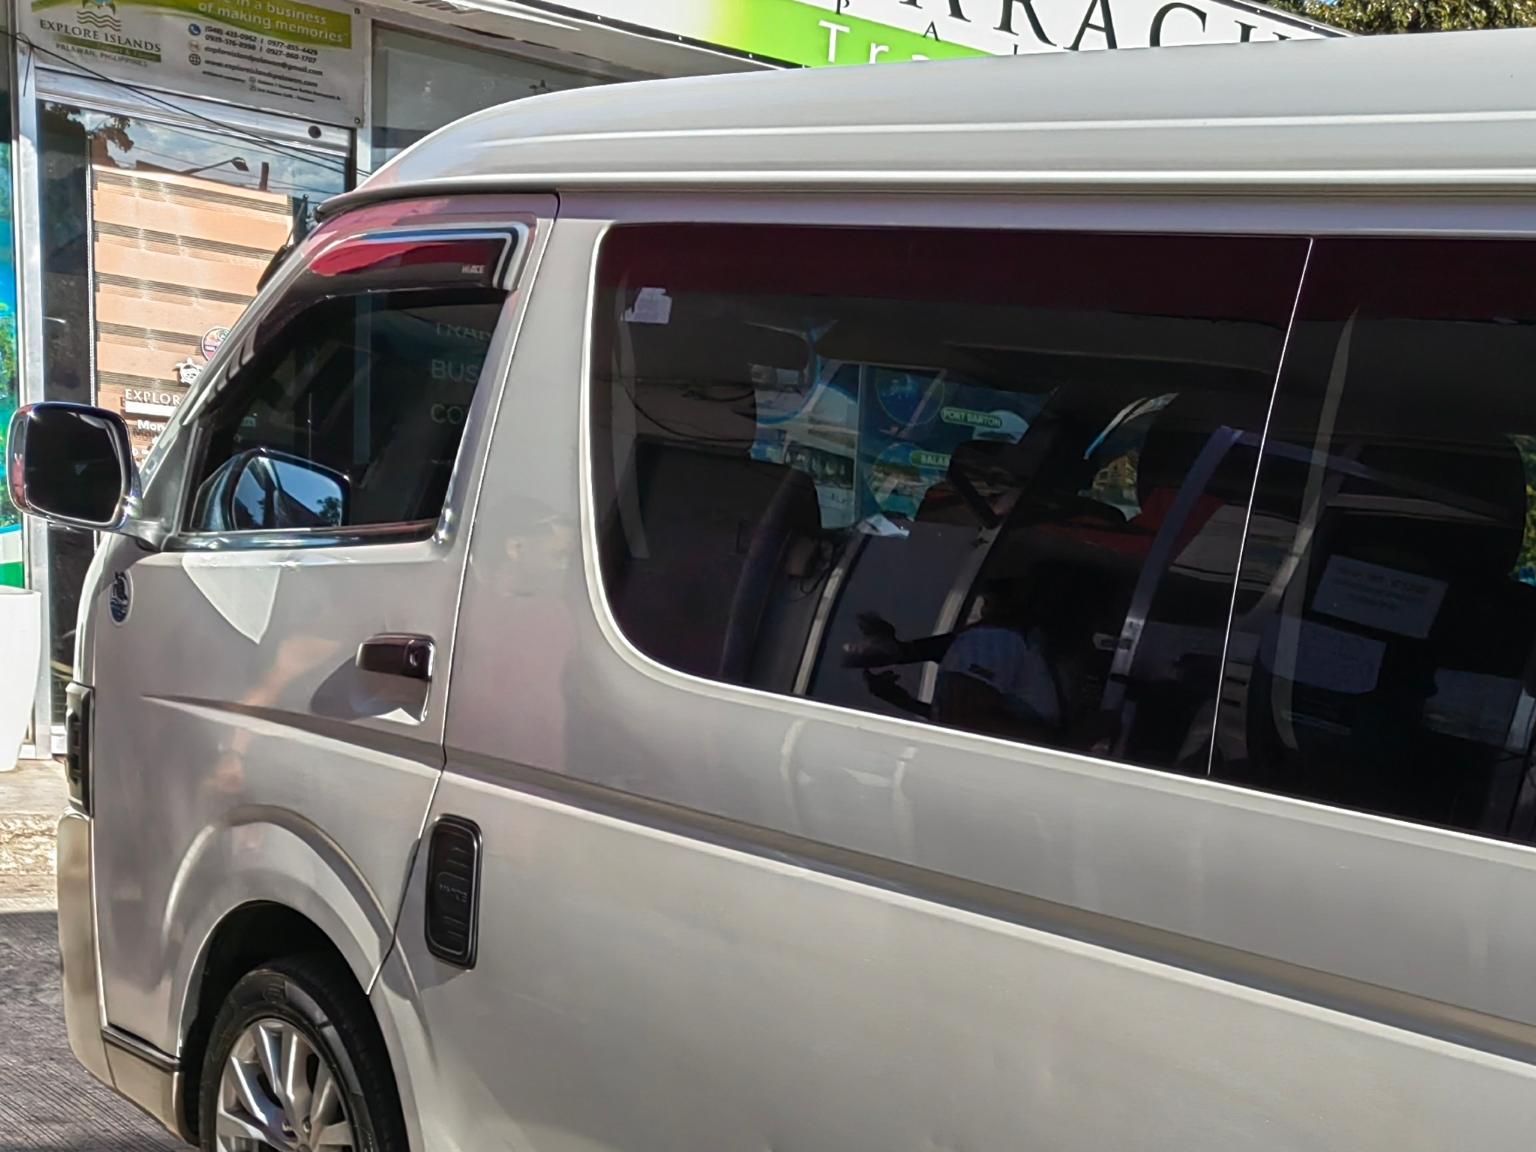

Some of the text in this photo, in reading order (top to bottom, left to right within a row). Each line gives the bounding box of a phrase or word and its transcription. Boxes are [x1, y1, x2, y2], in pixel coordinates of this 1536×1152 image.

[198, 2, 215, 14] of
[217, 6, 272, 31] making
[267, 1, 327, 26] business
[40, 18, 99, 40] EXPLORE
[104, 32, 161, 53] ISLANDS
